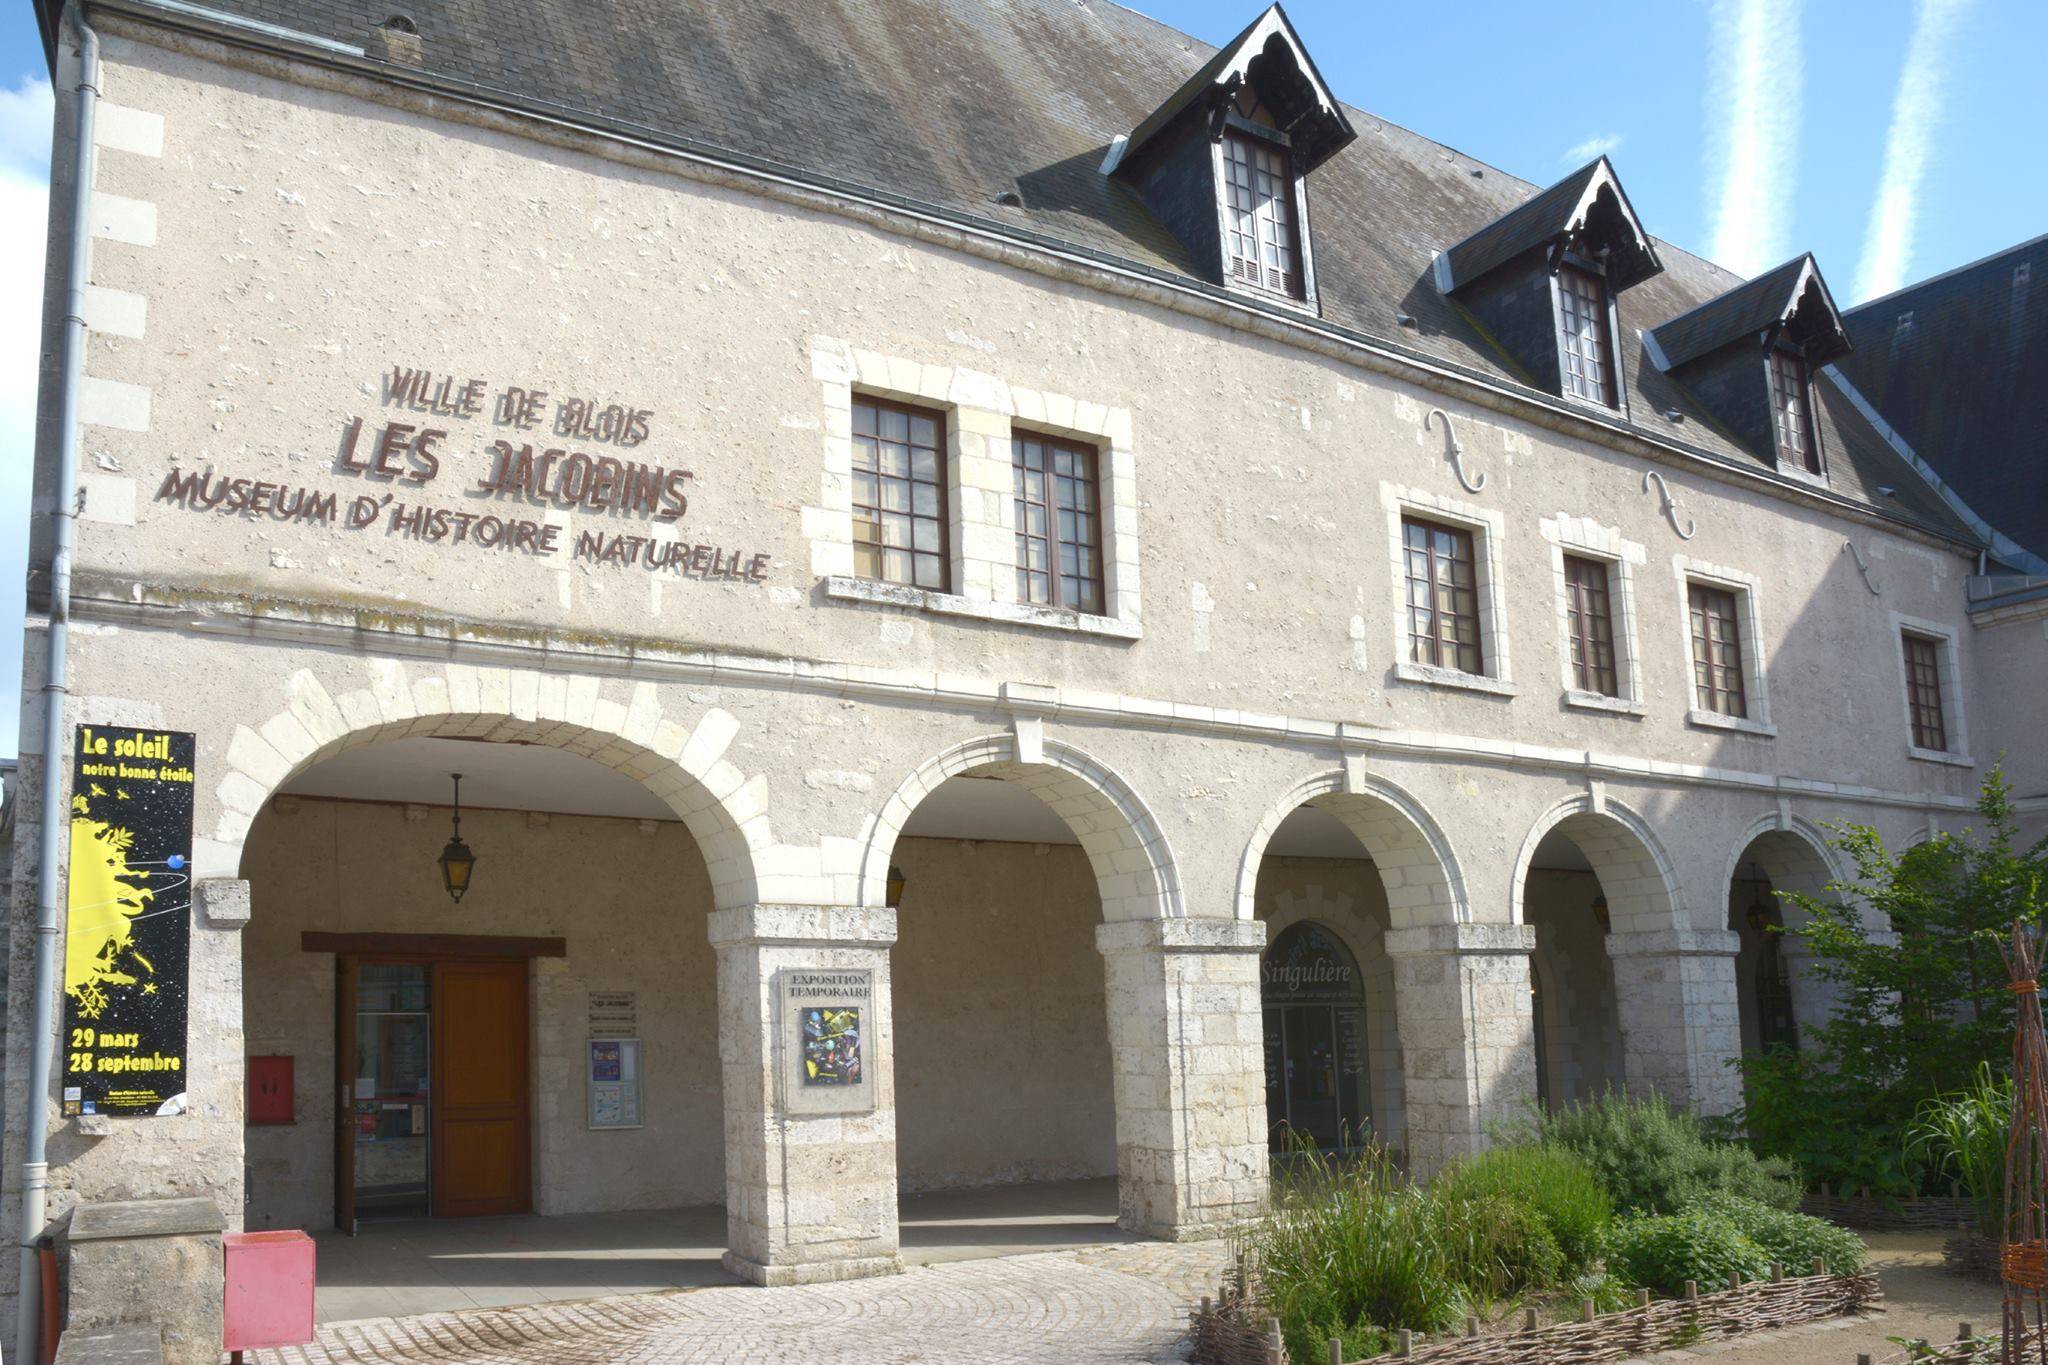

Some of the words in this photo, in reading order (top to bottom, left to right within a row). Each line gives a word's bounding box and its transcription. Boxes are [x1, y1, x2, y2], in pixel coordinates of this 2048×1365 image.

[391, 365, 488, 414] VILLE
[501, 386, 549, 424] DE
[563, 397, 655, 442] BLOIS
[341, 415, 448, 481] LES
[477, 439, 694, 519] JACOBINS
[159, 467, 337, 523] MUSEUM
[352, 492, 563, 553] D'HISTOIRE
[577, 529, 772, 581] NATURELLE
[83, 728, 109, 755] Le
[114, 733, 175, 763] soleil,
[82, 763, 117, 777] notre
[119, 762, 157, 779] bonne
[159, 766, 194, 782] étoile
[792, 974, 866, 985] EXPOSITION
[1263, 956, 1351, 992] Singulière
[788, 986, 872, 998] TEMPORAIRE
[72, 1027, 96, 1048] 29
[99, 1033, 140, 1048] mars
[69, 1052, 94, 1072] 28
[97, 1051, 181, 1074] septembre
